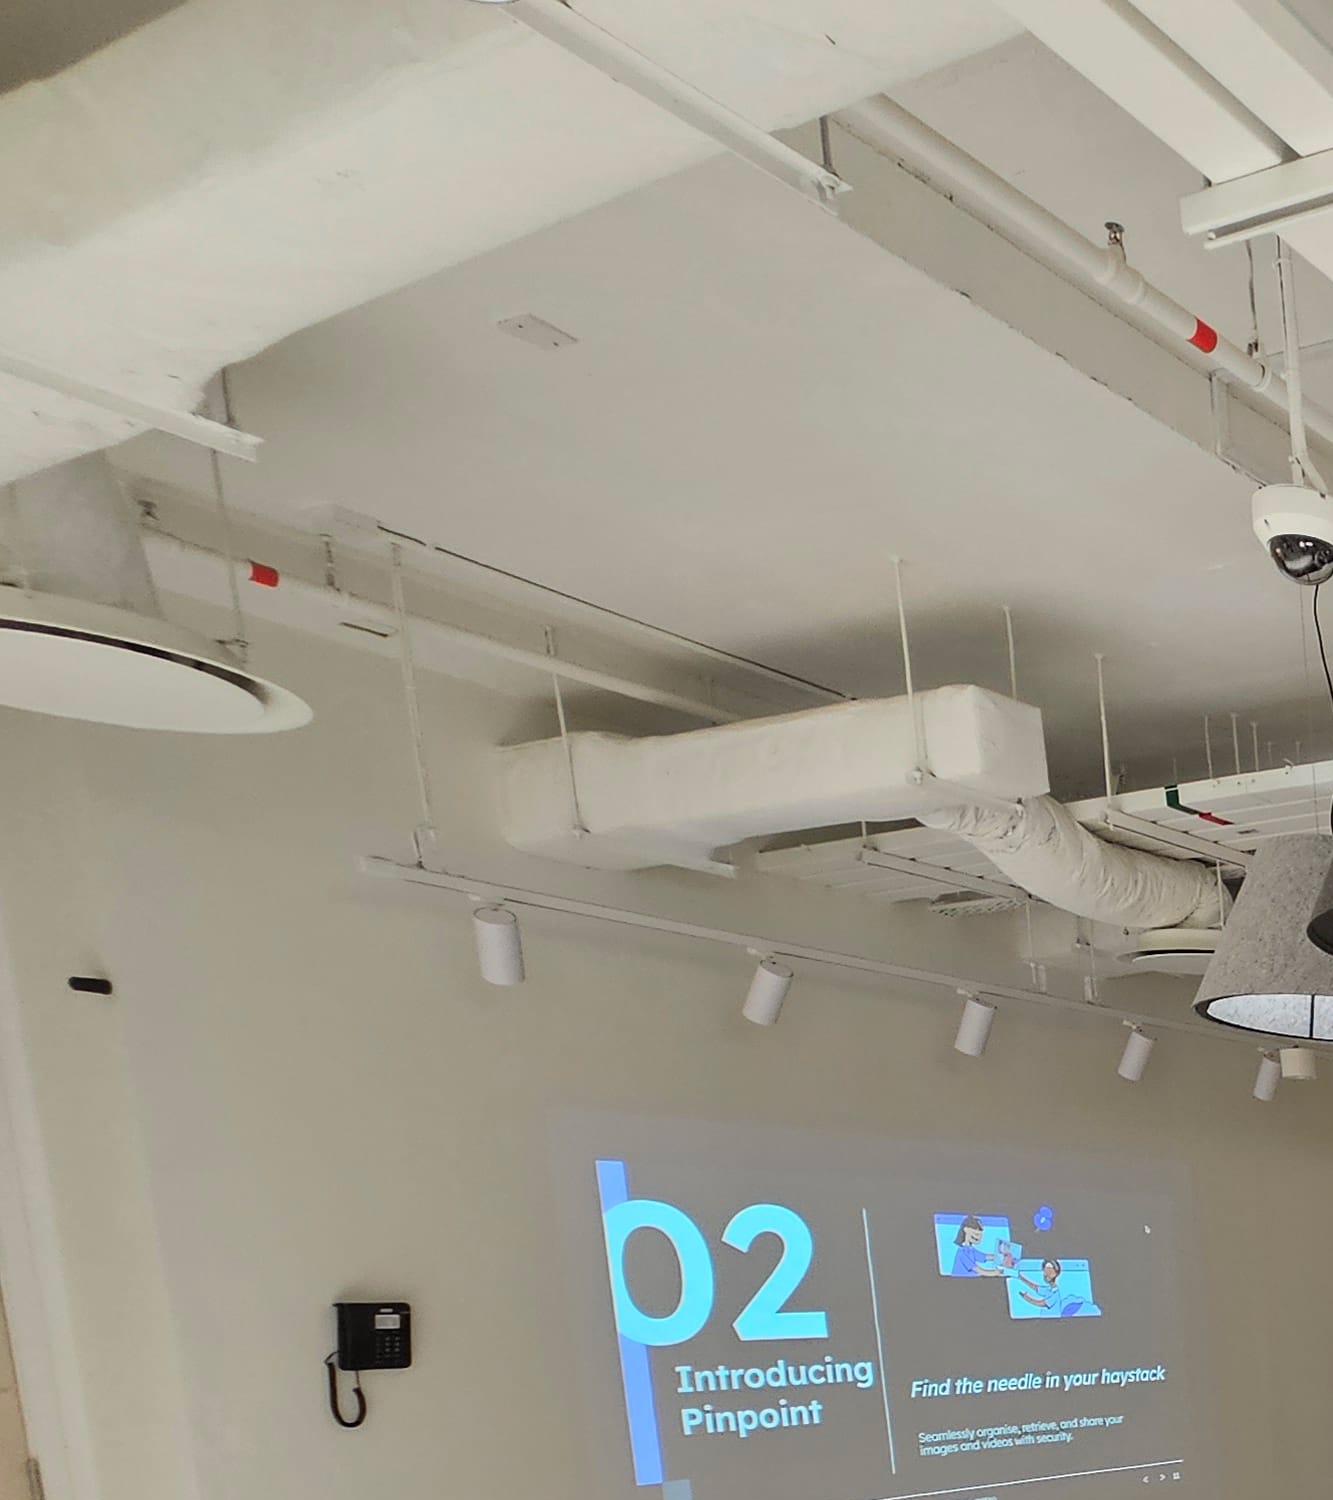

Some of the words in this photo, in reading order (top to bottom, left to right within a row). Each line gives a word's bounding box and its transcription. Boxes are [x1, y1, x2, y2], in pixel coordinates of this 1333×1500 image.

[602, 1200, 828, 1347] 02
[675, 1355, 874, 1393] Introducing
[910, 1378, 950, 1399] Find
[954, 1377, 983, 1395] the
[986, 1373, 1042, 1393] needle
[1045, 1370, 1060, 1389] in
[1063, 1372, 1099, 1391] your
[1101, 1365, 1165, 1388] haystack
[680, 1398, 824, 1438] Pinpoint
[918, 1428, 976, 1443] Seamlessly
[976, 1423, 1021, 1440] organise,
[1022, 1420, 1060, 1432] retrieve,
[1060, 1418, 1079, 1430] and
[1079, 1416, 1104, 1428] share
[1103, 1415, 1124, 1427] your
[919, 1444, 959, 1457] images
[960, 1439, 981, 1451] and
[981, 1437, 1014, 1450] videos
[1014, 1434, 1035, 1446] with
[1036, 1431, 1075, 1444] security.
